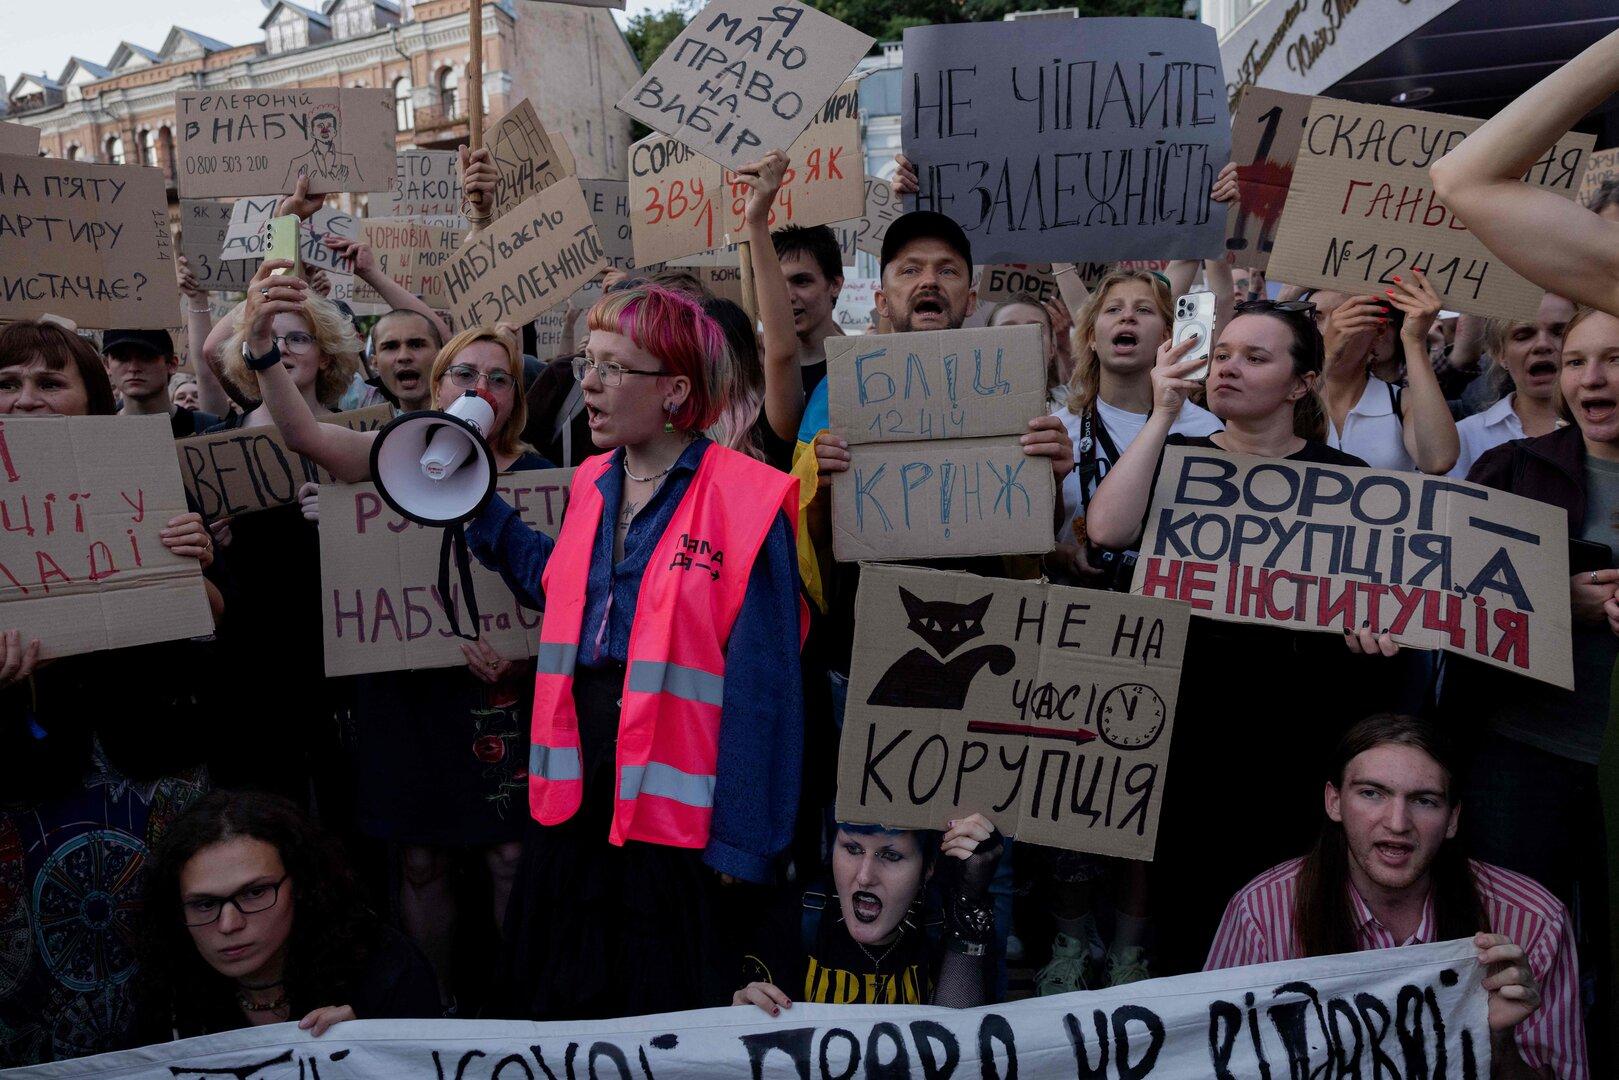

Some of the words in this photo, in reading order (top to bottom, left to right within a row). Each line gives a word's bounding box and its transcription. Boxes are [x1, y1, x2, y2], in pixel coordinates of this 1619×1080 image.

[706, 13, 806, 70] МАЮ
[758, 6, 804, 37] Я
[673, 38, 803, 120] ПРАВО
[698, 80, 738, 113] НА
[913, 65, 976, 139] НЕ
[1012, 51, 1216, 133] ЧІПАЙТЕ
[185, 121, 200, 141] В
[212, 112, 309, 144] НАБУ
[633, 77, 761, 156] ВИБІР
[185, 156, 217, 174] 0800
[222, 156, 243, 173] 503
[248, 156, 269, 172] 200
[486, 107, 548, 178] КОН
[805, 146, 843, 184] ЯК
[392, 180, 463, 201] ЗАКОН
[1341, 179, 1467, 230] ГАНЬ
[0, 214, 124, 253] АРТИРУ
[440, 232, 460, 250] НЕ
[0, 272, 148, 301] ИСТАЧАЄ?
[868, 407, 965, 438] 12414
[1174, 456, 1489, 530] ВОРОГ
[1142, 558, 1216, 610] НЕ
[1467, 547, 1534, 613] А
[1015, 597, 1091, 648] НЕ
[1111, 614, 1165, 666] НА
[860, 722, 1158, 836] КОРУПЦІЯ
